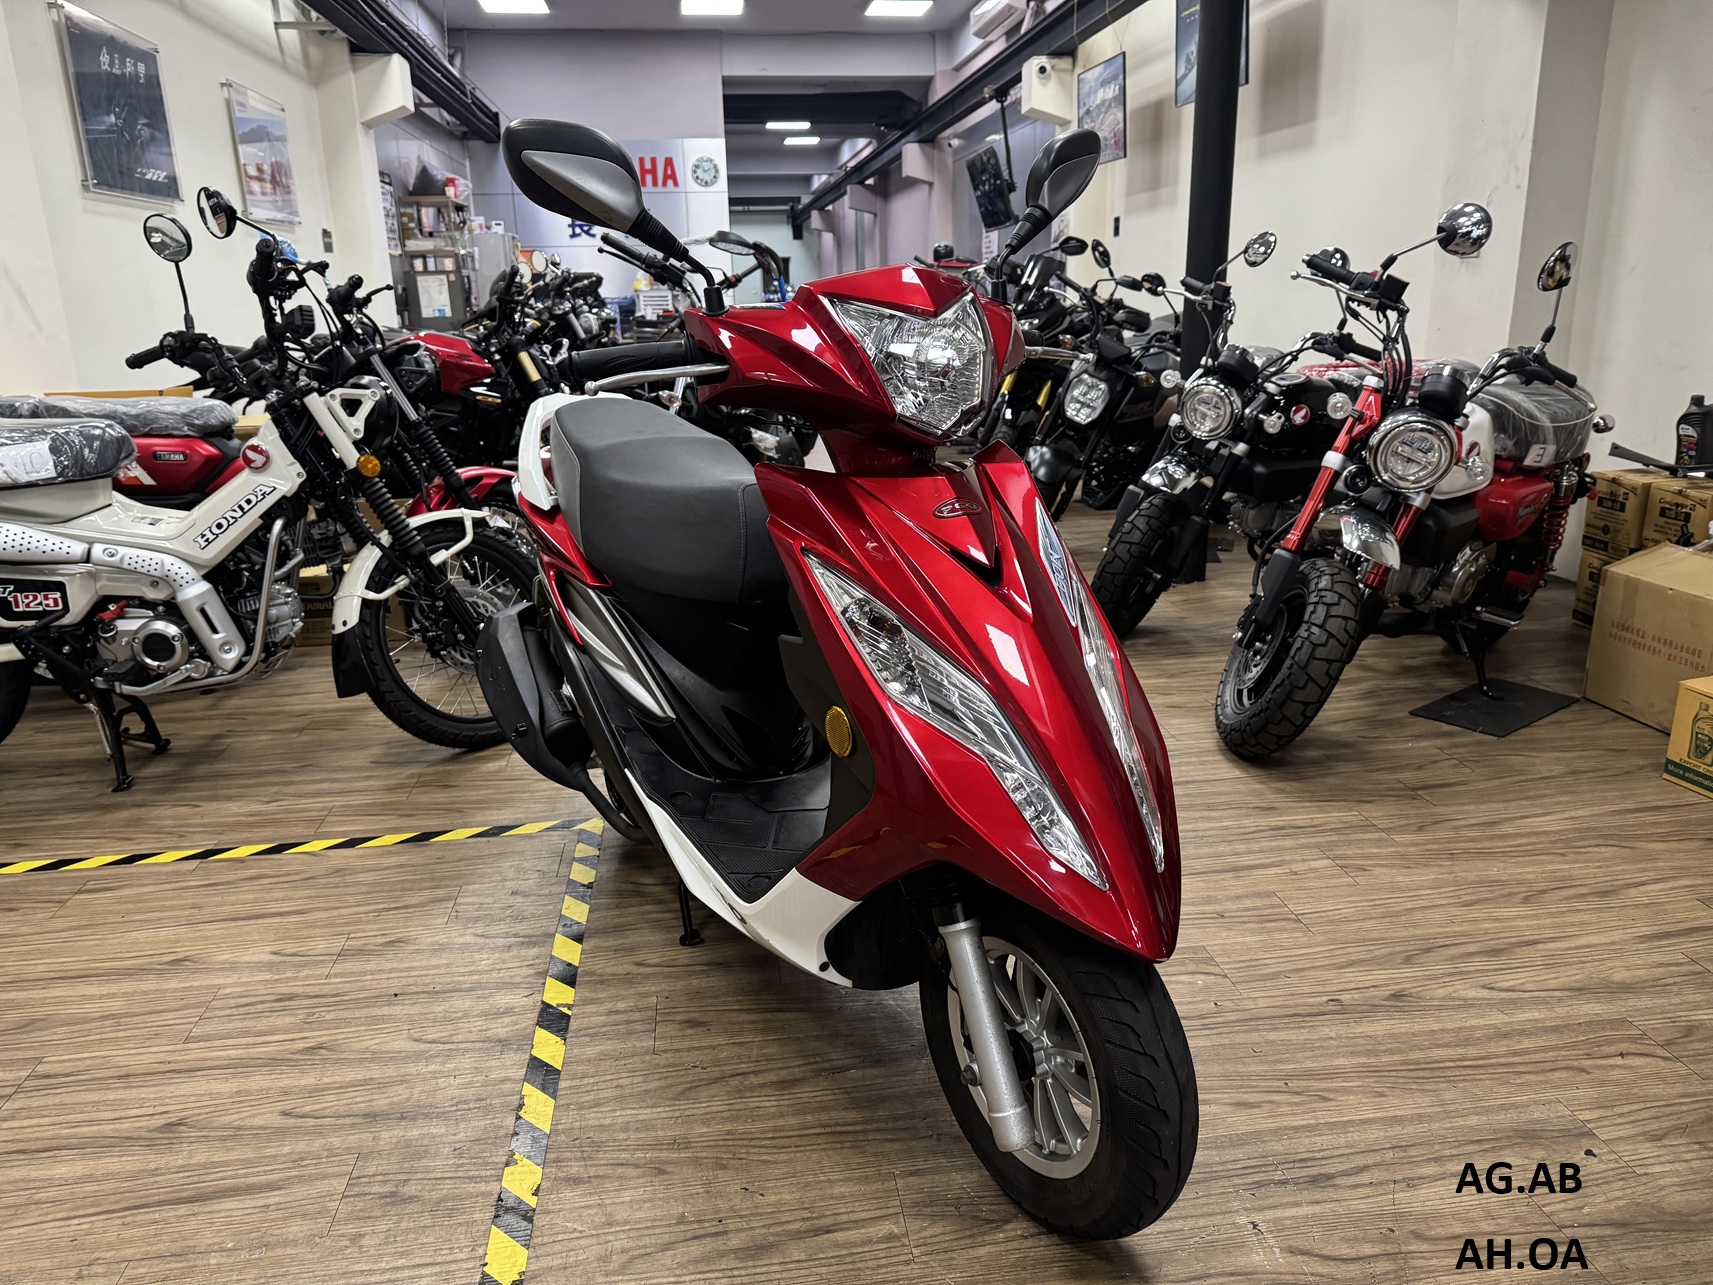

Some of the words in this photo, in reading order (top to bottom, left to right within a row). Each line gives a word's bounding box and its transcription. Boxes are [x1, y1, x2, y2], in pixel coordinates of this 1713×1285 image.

[638, 156, 680, 188] HA
[193, 484, 276, 550] HONDA
[8, 592, 63, 611] 125
[1667, 763, 1684, 775] More
[1679, 757, 1702, 770] EXPORT
